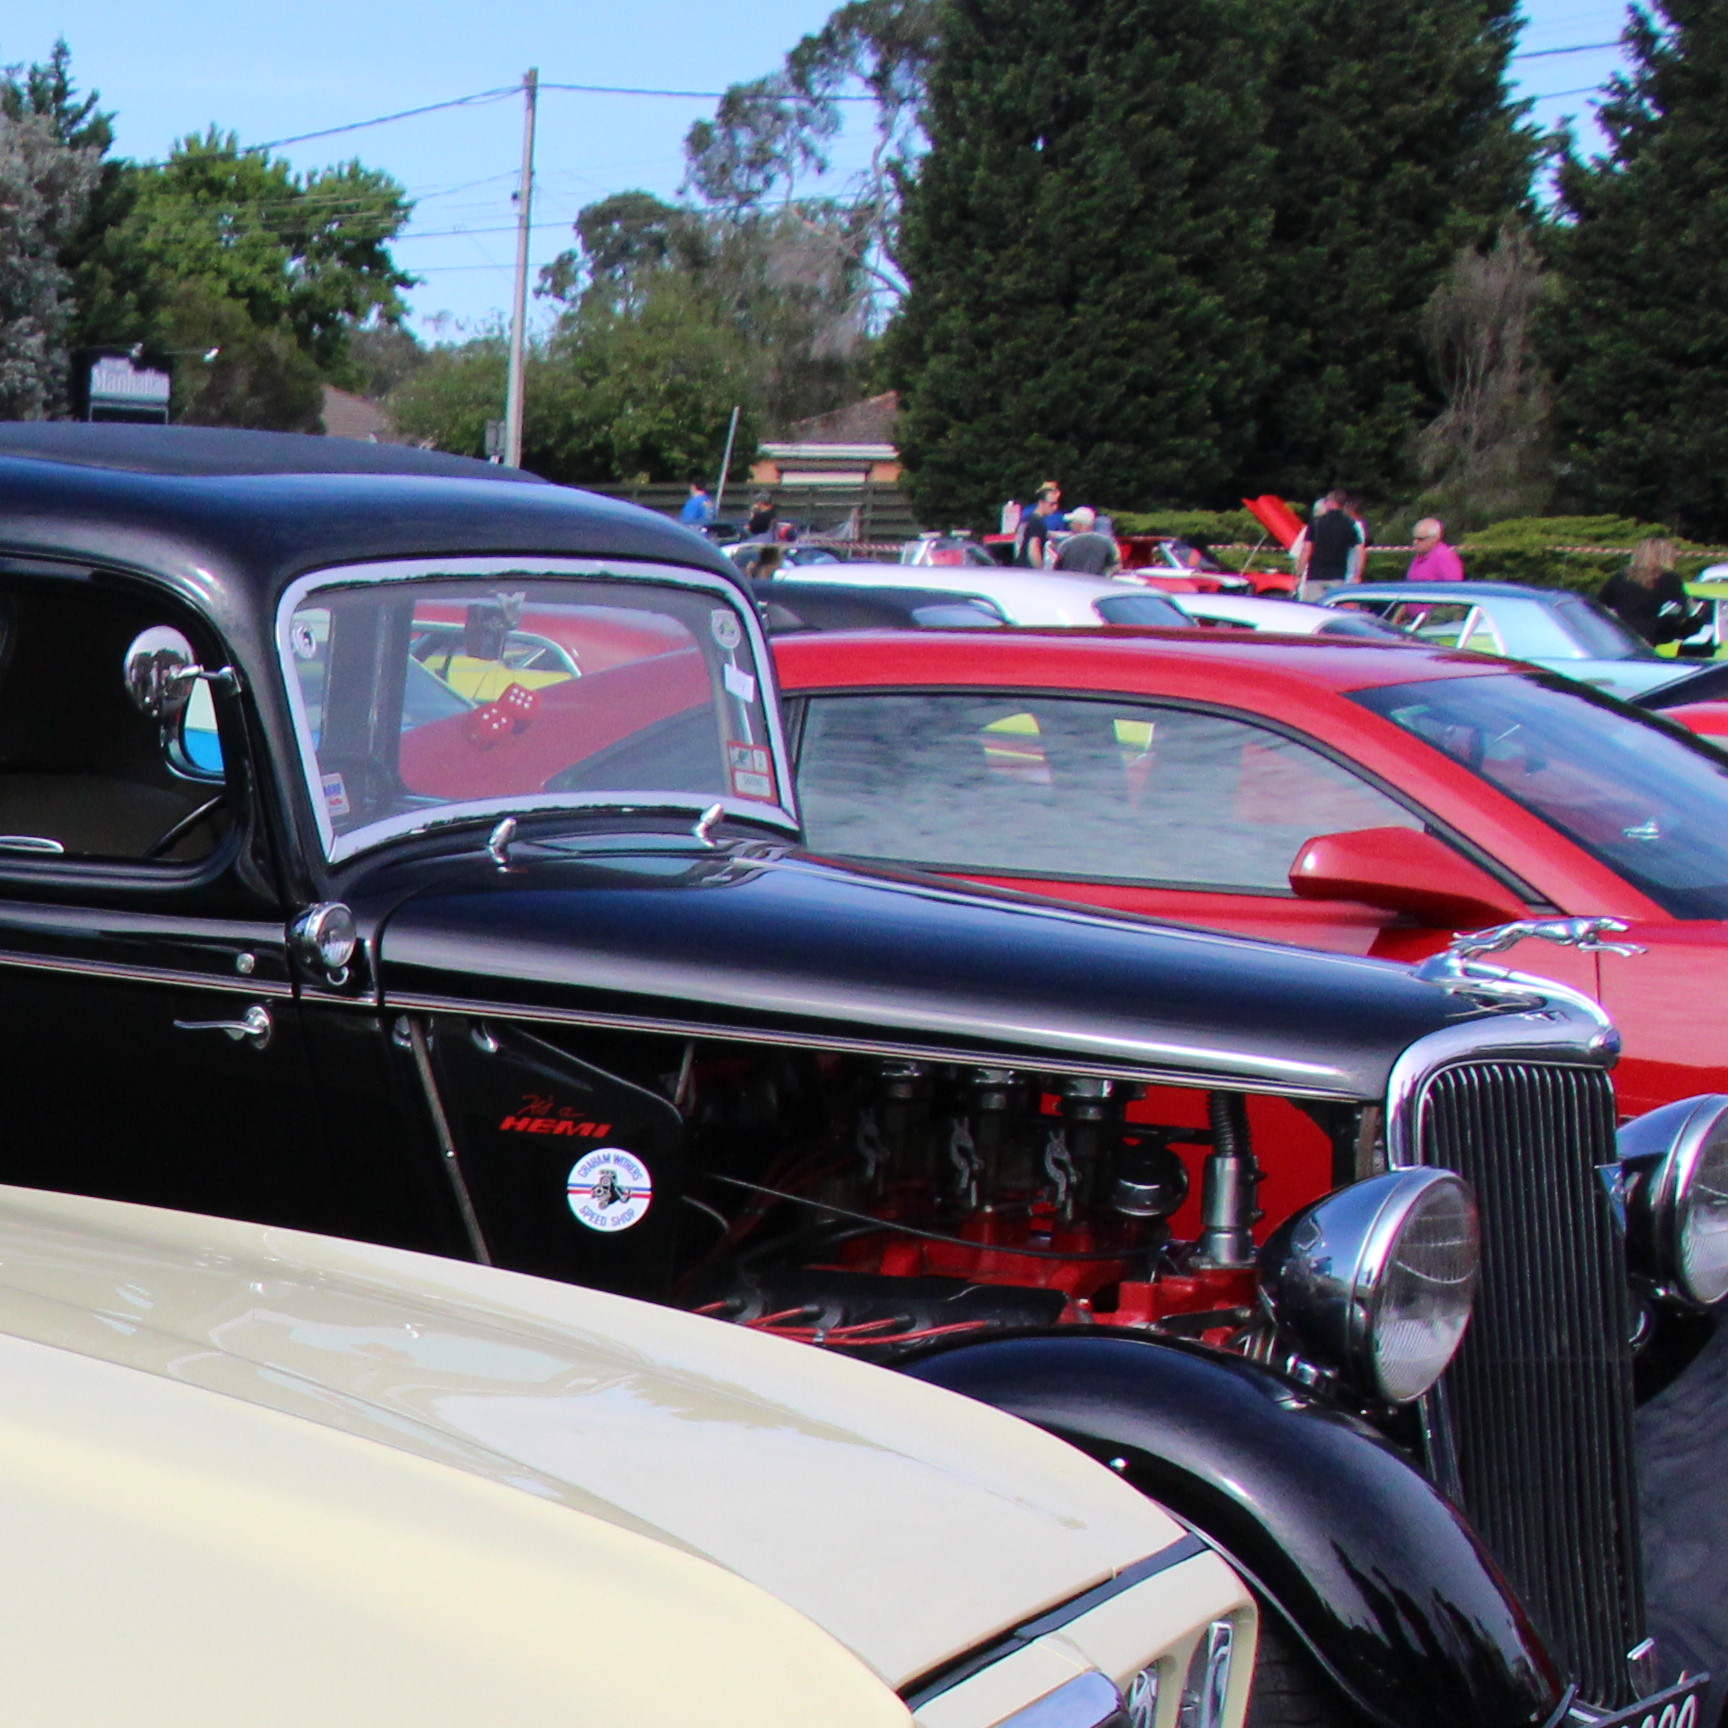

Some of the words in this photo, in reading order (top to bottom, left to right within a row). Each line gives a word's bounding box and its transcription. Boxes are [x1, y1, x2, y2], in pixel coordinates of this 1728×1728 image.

[499, 1116, 613, 1138] HEMI
[578, 1205, 607, 1227] SPEED
[611, 1207, 636, 1228] SHOP
